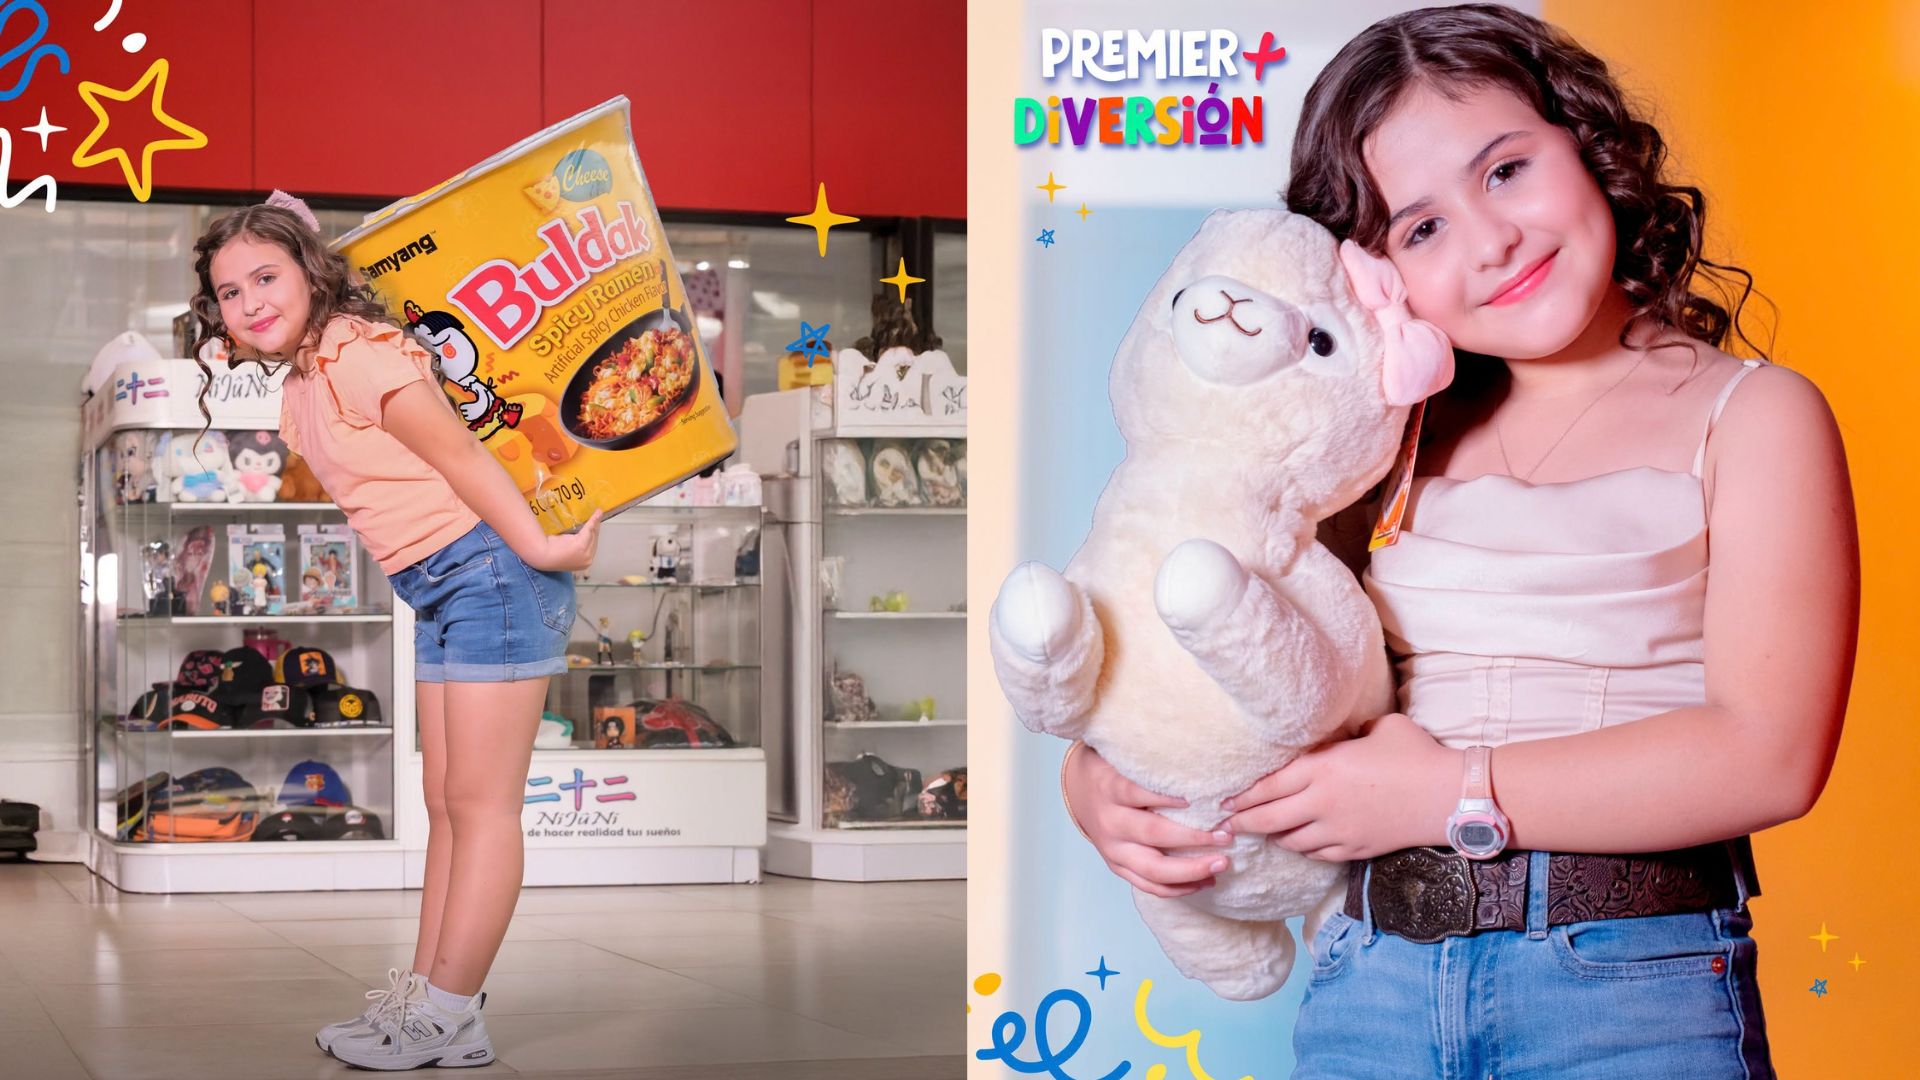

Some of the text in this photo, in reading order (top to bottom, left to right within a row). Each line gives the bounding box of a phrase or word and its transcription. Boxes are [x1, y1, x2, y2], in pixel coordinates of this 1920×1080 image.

[360, 233, 437, 281] Samyang
[448, 202, 650, 349] Buldak
[529, 261, 654, 355] Spicy Ramen
[544, 340, 586, 384] Artificial
[581, 317, 612, 345] Spicy
[608, 293, 645, 323] Chicken
[527, 827, 682, 837] de hacer realidad tus sueños
